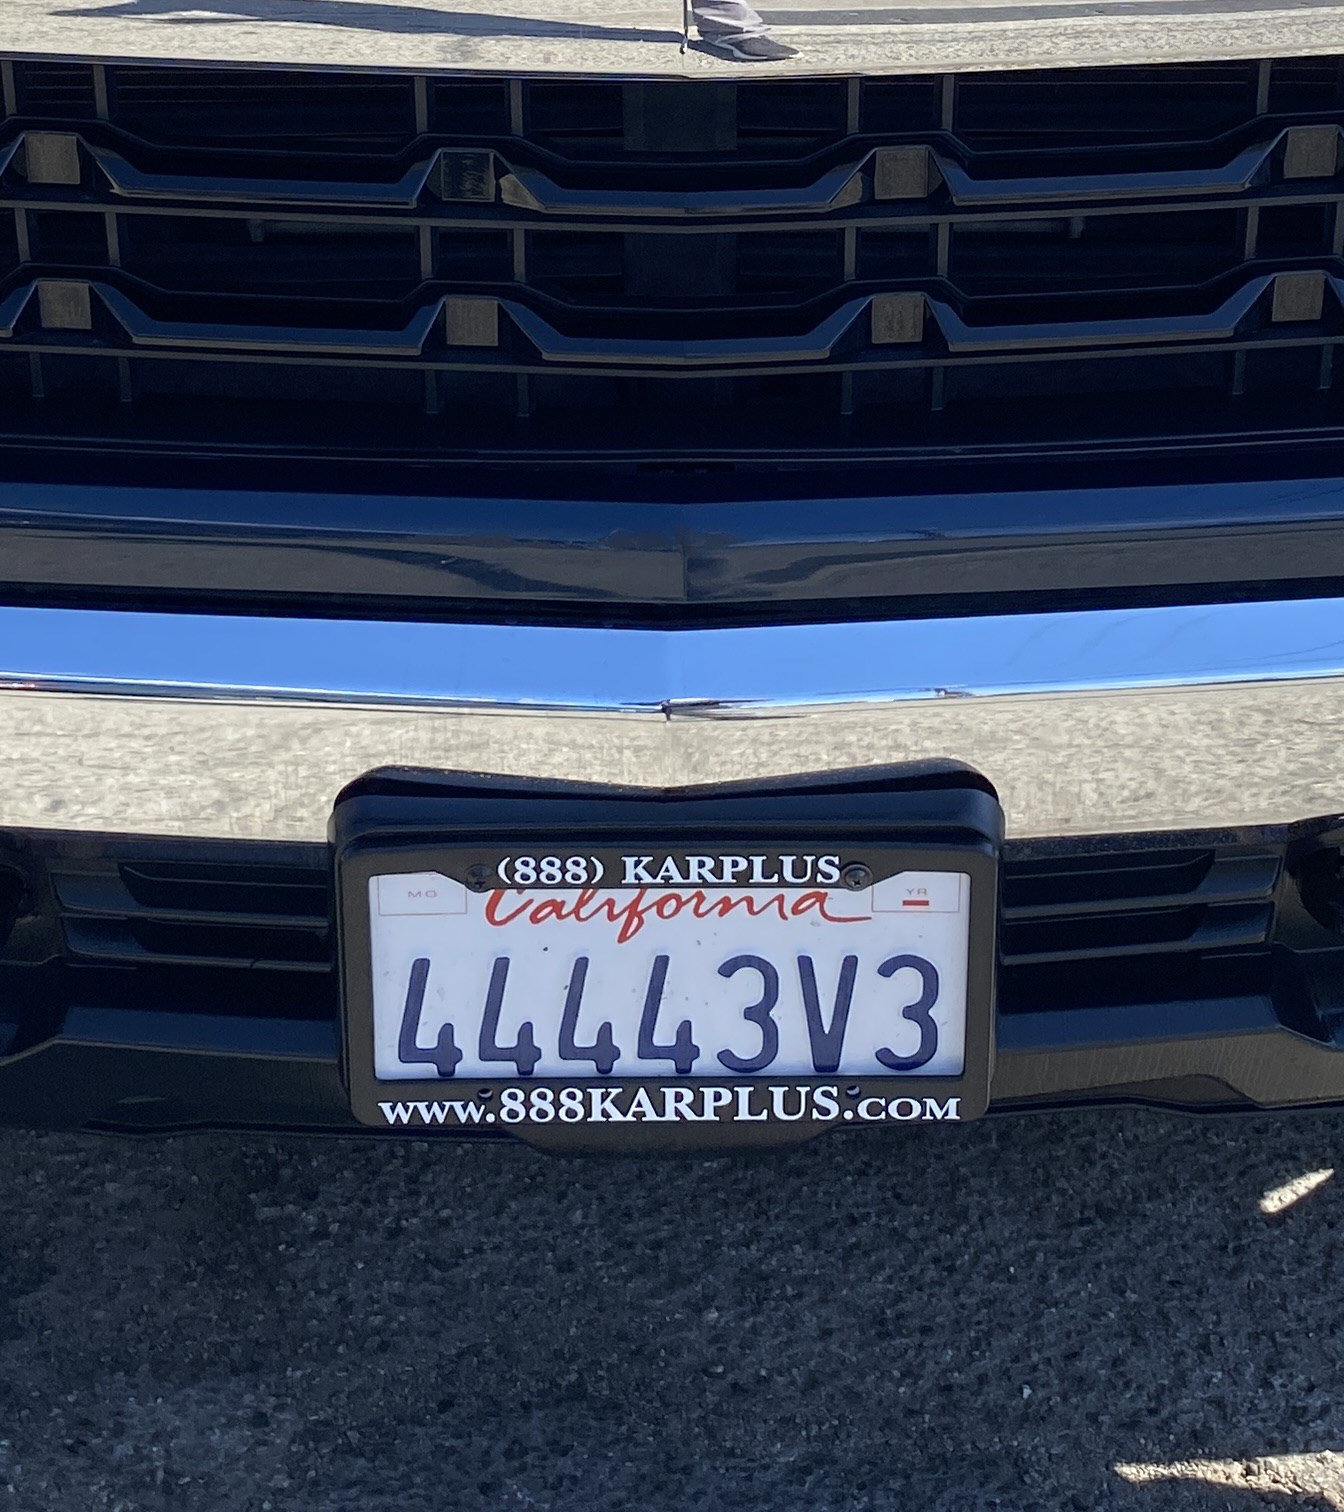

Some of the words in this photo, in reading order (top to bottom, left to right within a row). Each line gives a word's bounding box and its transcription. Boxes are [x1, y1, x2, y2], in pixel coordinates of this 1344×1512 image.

[496, 854, 604, 886] (888)
[621, 854, 841, 886] KARPLUS
[482, 887, 872, 943] California
[397, 954, 940, 1077] 44443V3
